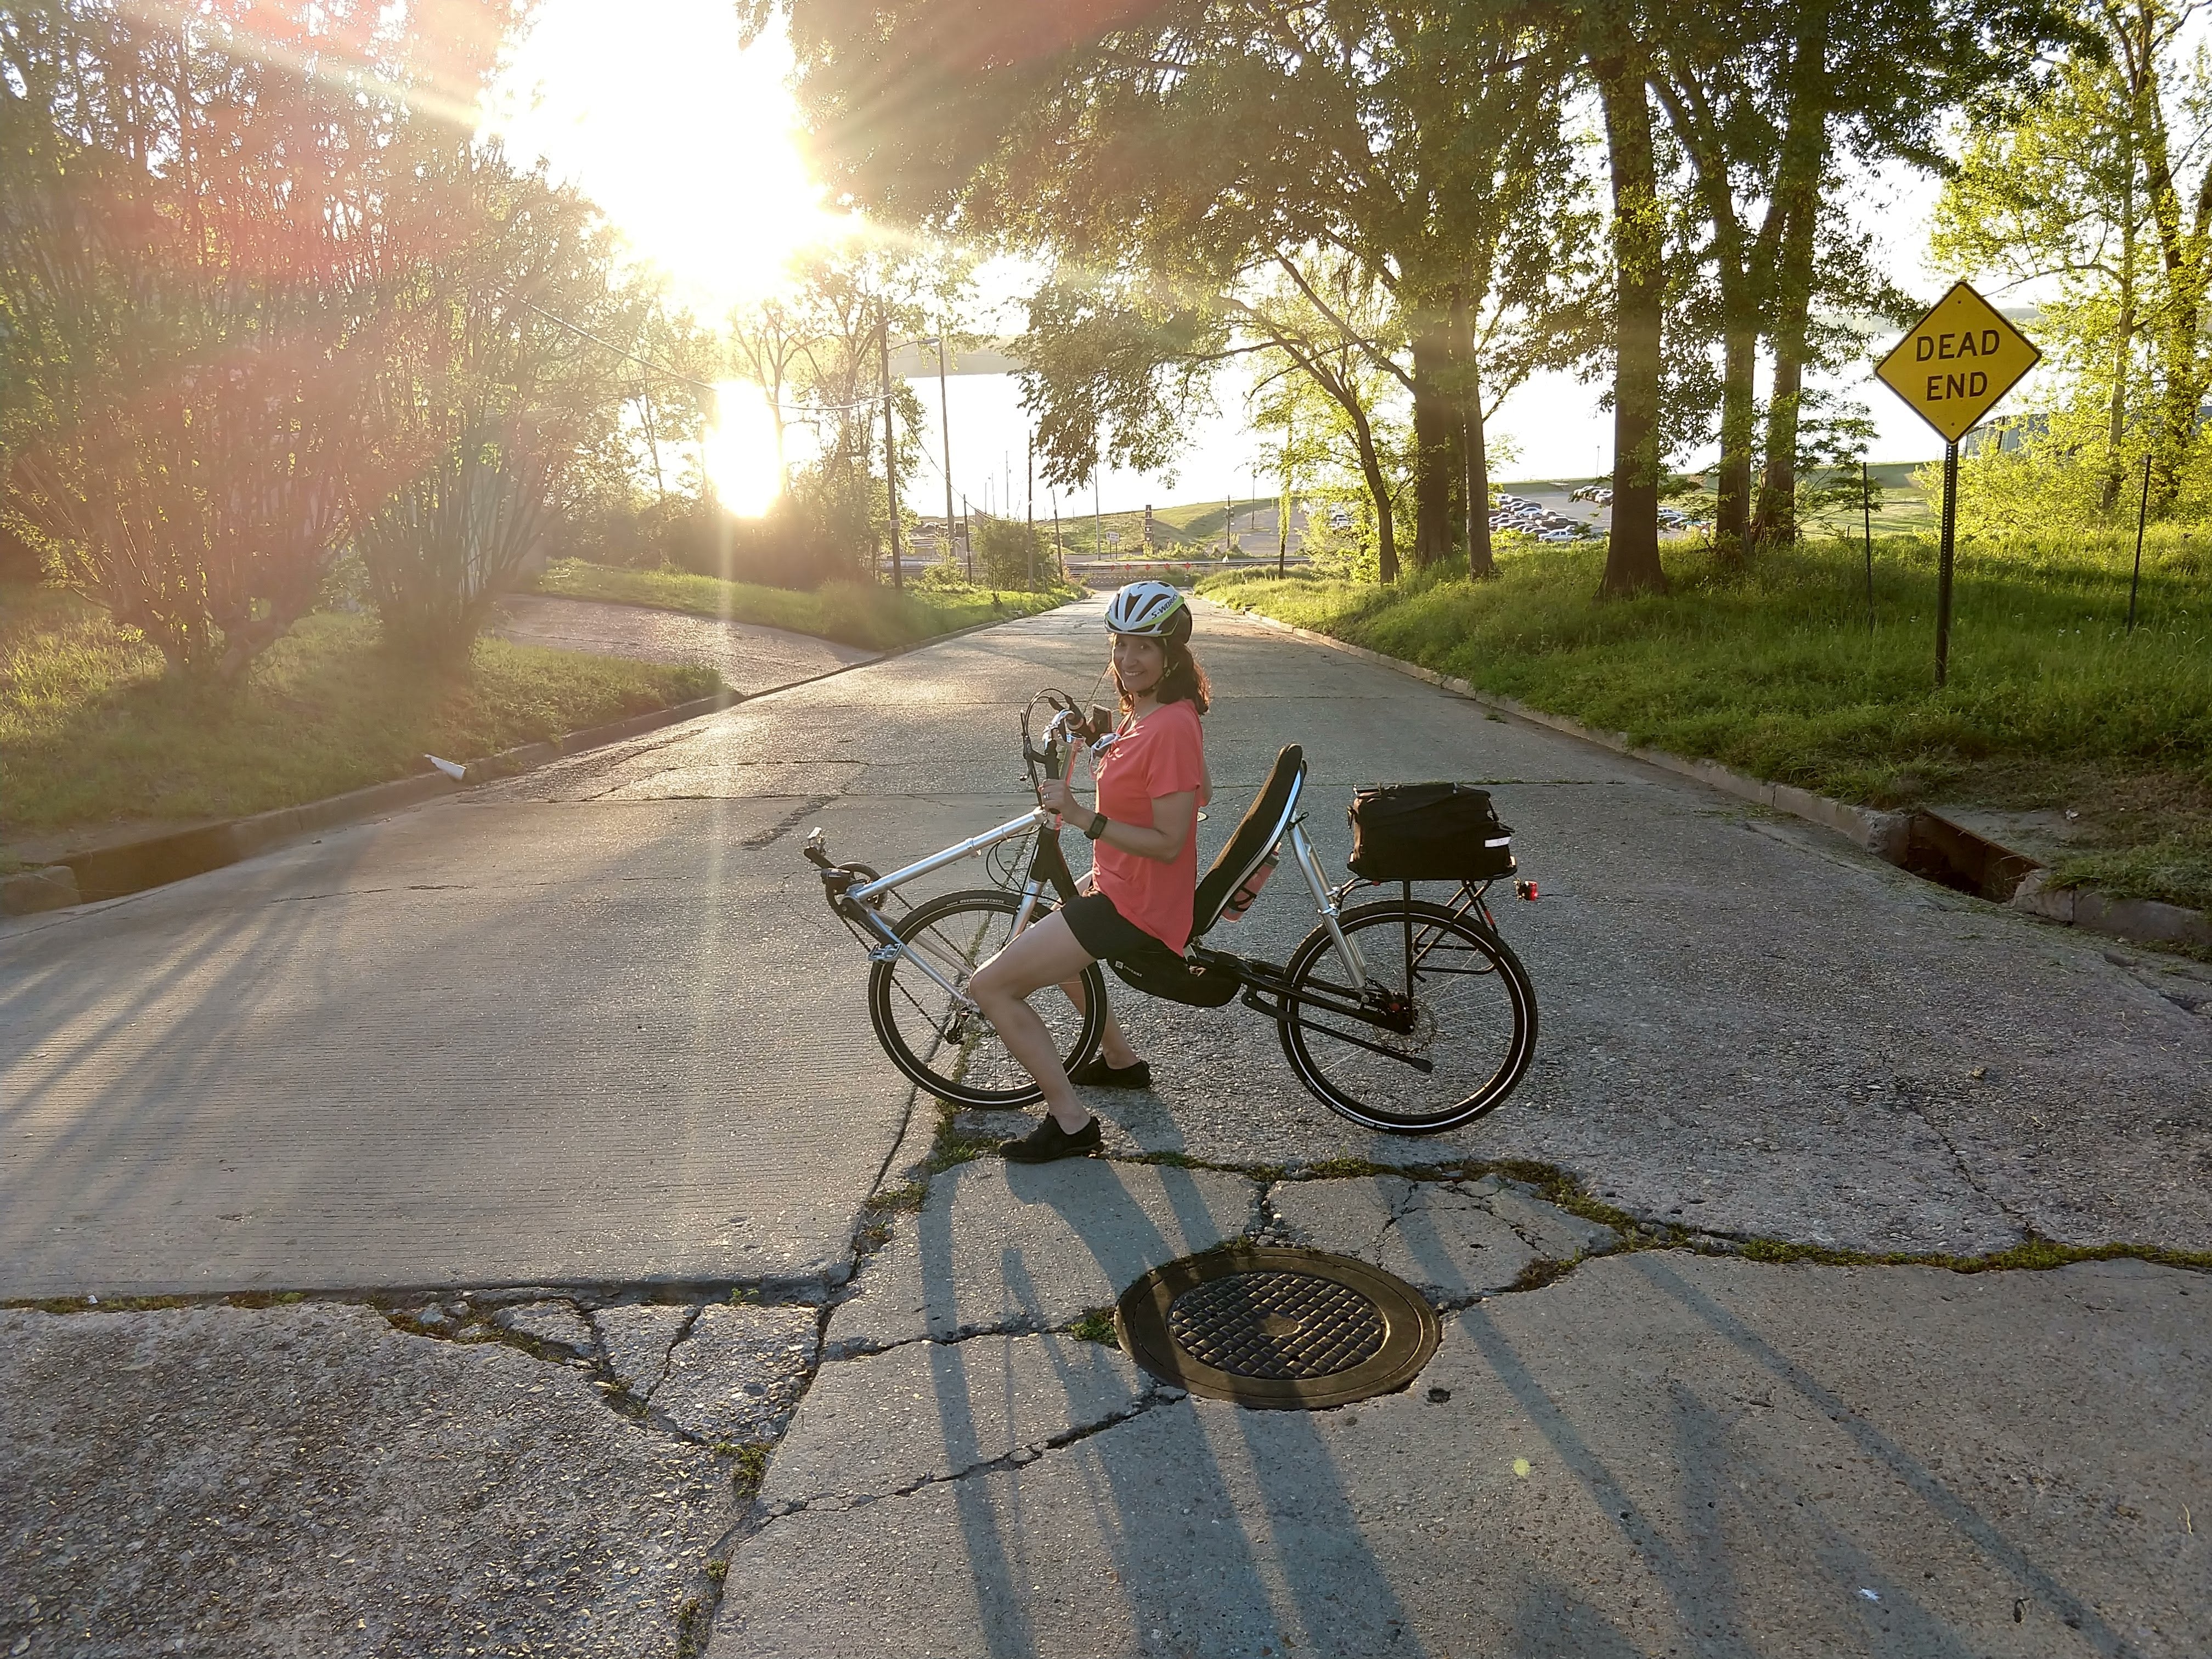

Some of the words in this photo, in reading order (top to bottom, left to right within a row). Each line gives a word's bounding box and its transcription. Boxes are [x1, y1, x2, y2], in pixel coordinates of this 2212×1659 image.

[1916, 329, 2000, 362] DEAD
[1926, 371, 1988, 401] END
[1151, 594, 1177, 619] S-WORKS
